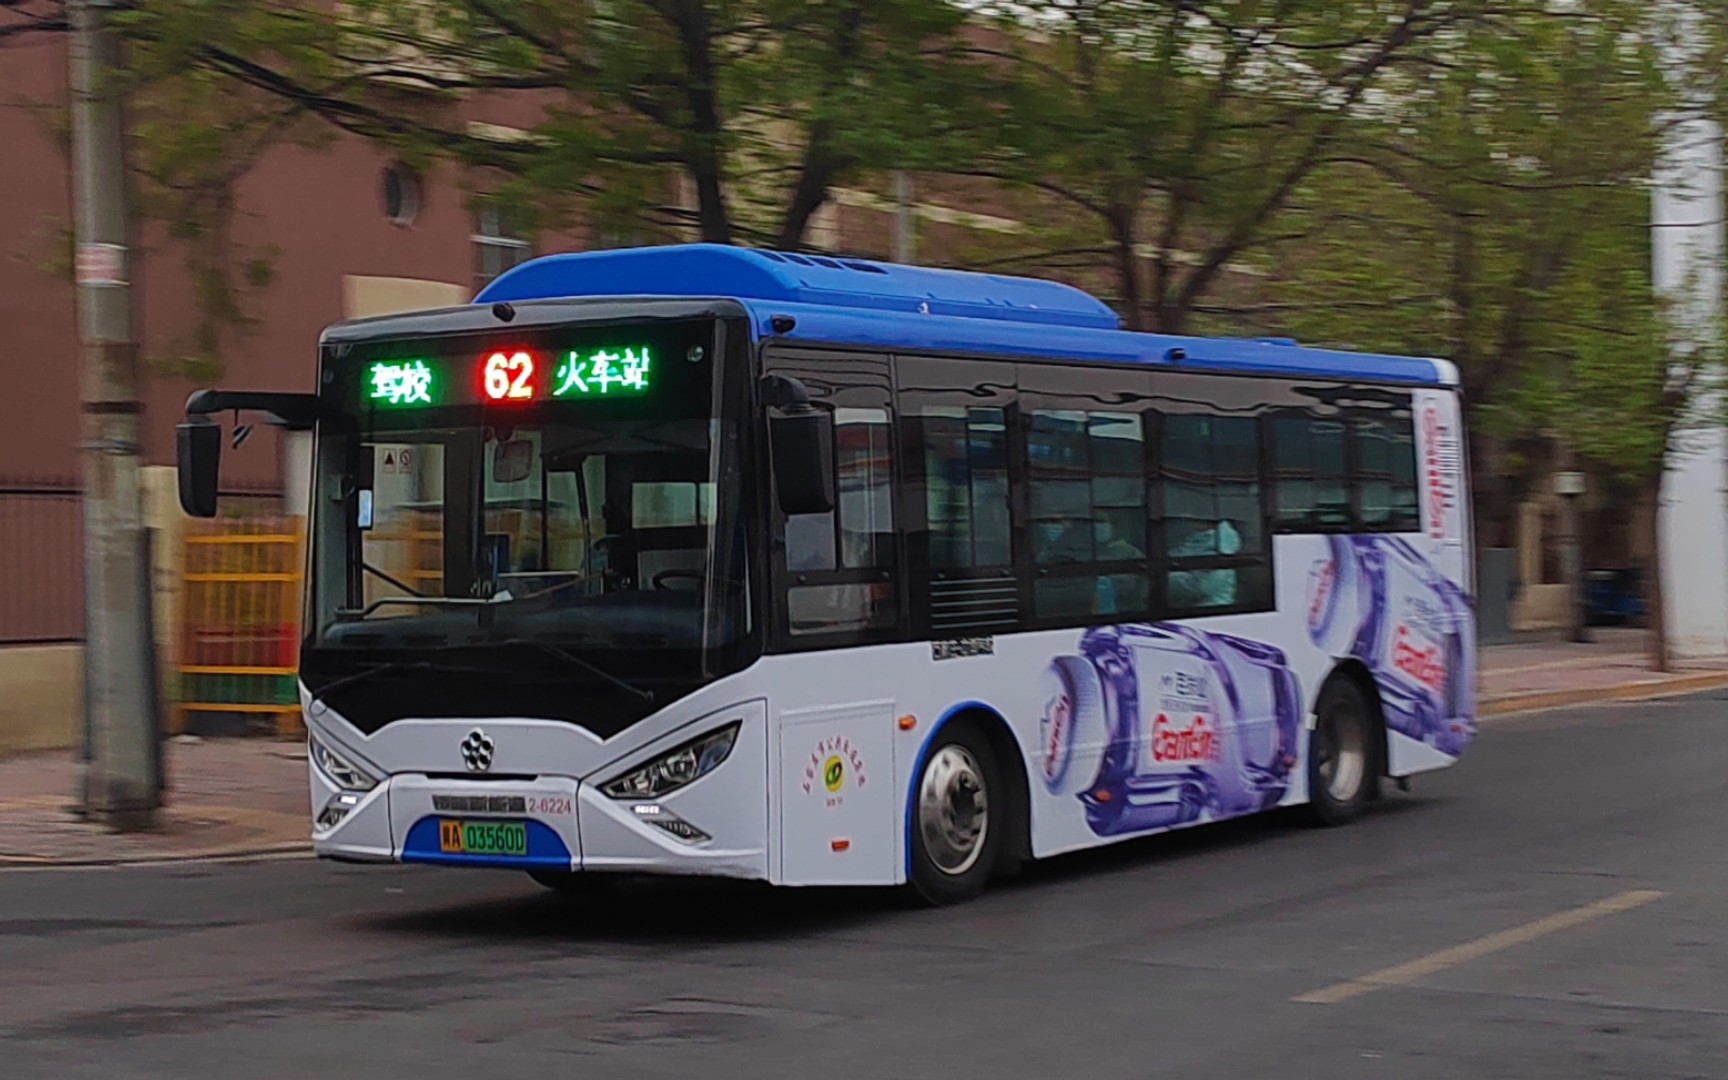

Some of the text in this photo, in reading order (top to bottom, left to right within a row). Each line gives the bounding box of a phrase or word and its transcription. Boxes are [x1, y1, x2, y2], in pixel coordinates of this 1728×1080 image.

[370, 347, 650, 403] 驾校 62 火车站
